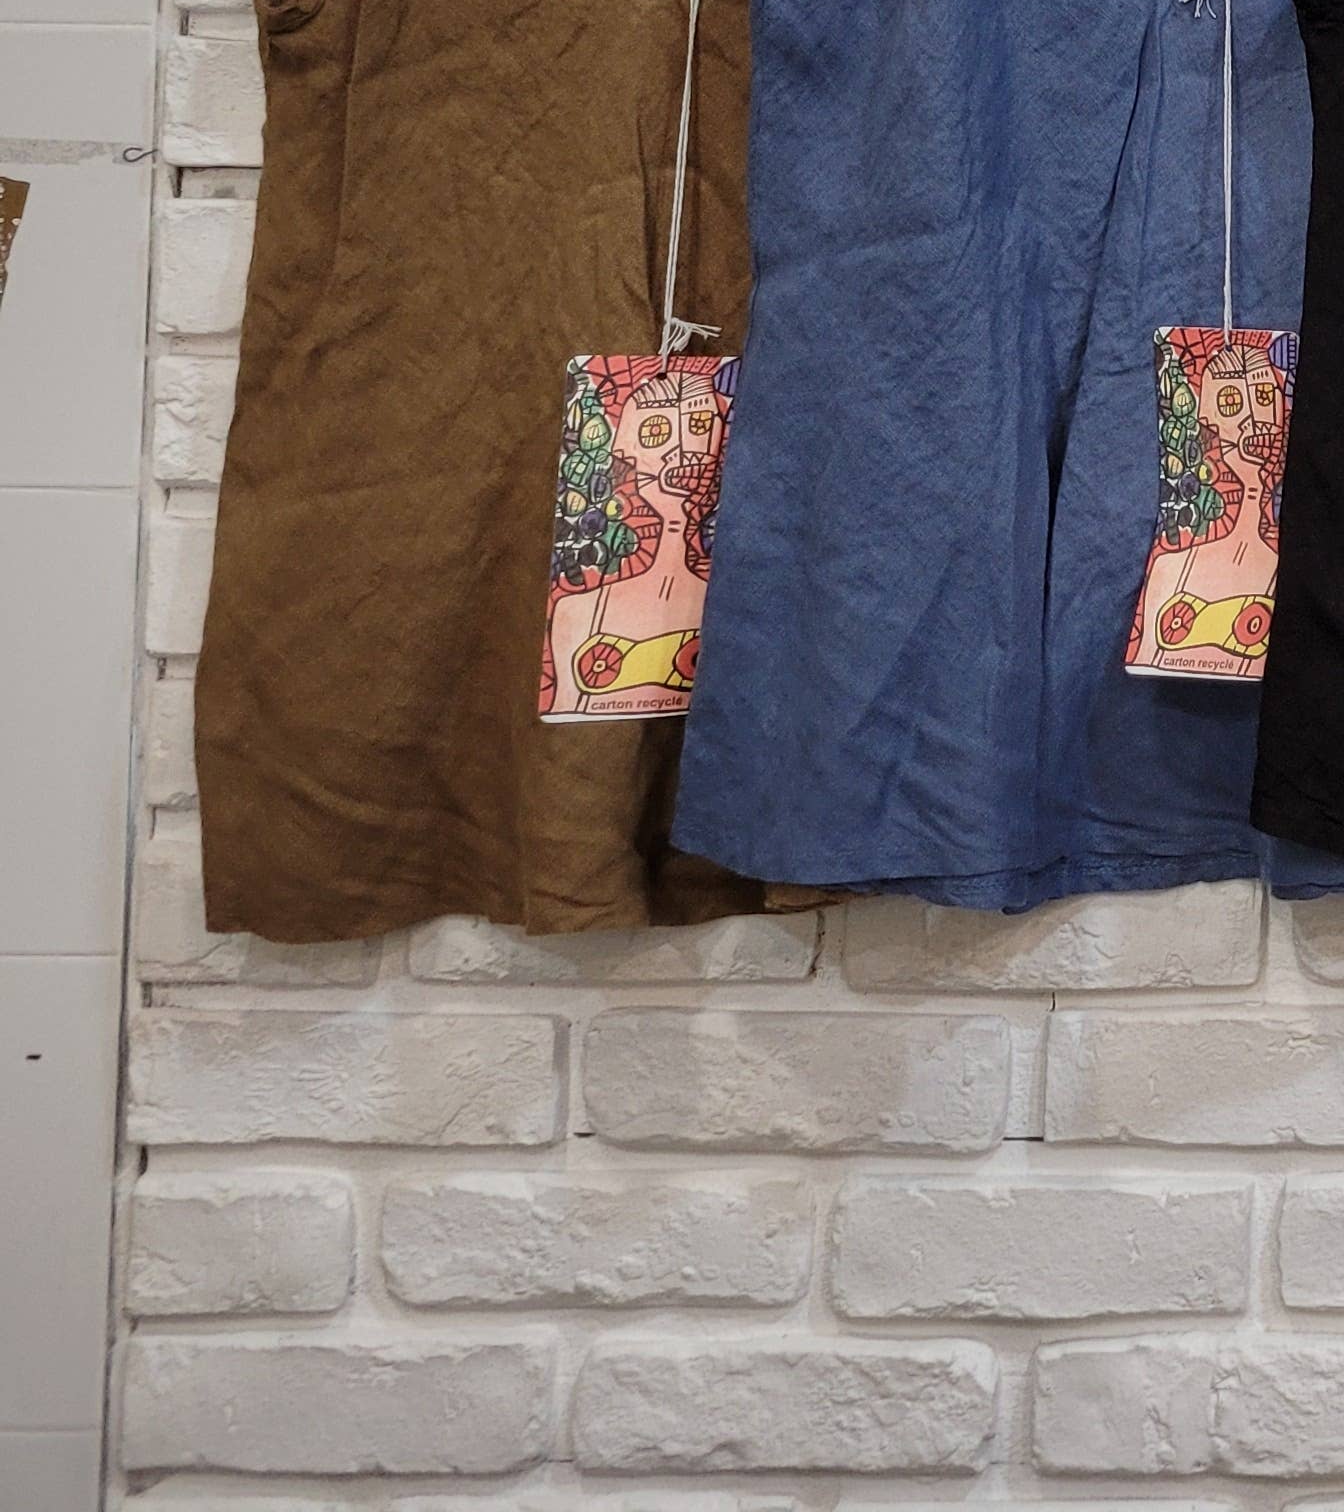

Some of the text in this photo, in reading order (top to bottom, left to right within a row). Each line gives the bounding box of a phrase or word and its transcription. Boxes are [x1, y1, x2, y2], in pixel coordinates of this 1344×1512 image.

[1163, 657, 1234, 671] carton recyclé
[591, 700, 633, 711] carton
